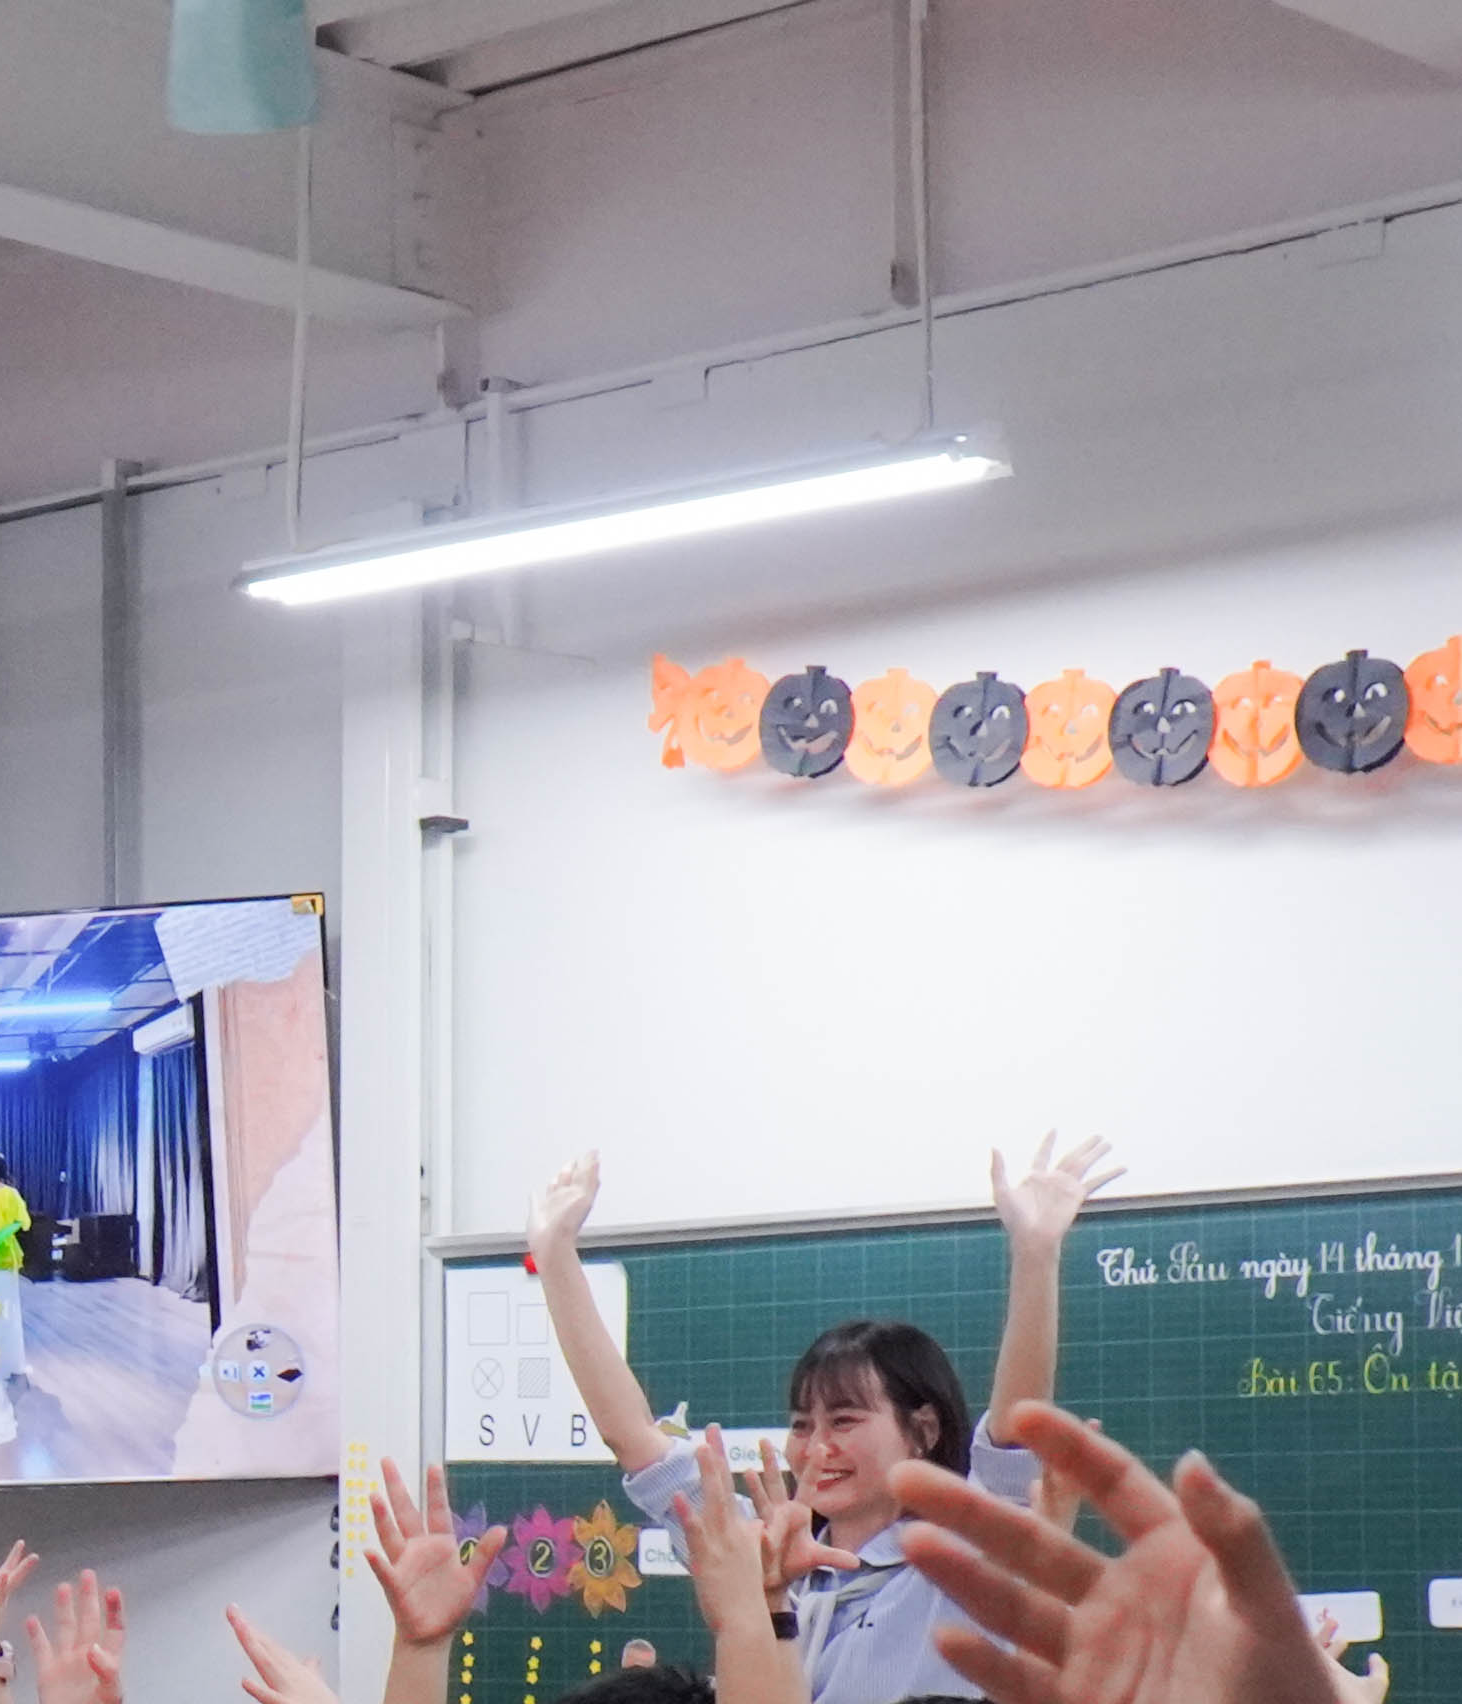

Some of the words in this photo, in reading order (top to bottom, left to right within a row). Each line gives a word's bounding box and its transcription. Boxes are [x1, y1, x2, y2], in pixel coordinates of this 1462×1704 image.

[1239, 1251, 1312, 1300] ngày
[1354, 1230, 1443, 1290] tháng
[479, 1414, 495, 1446] S
[523, 1414, 540, 1446] V
[571, 1414, 587, 1446] B
[534, 1540, 550, 1573] 2
[592, 1541, 608, 1575] 3
